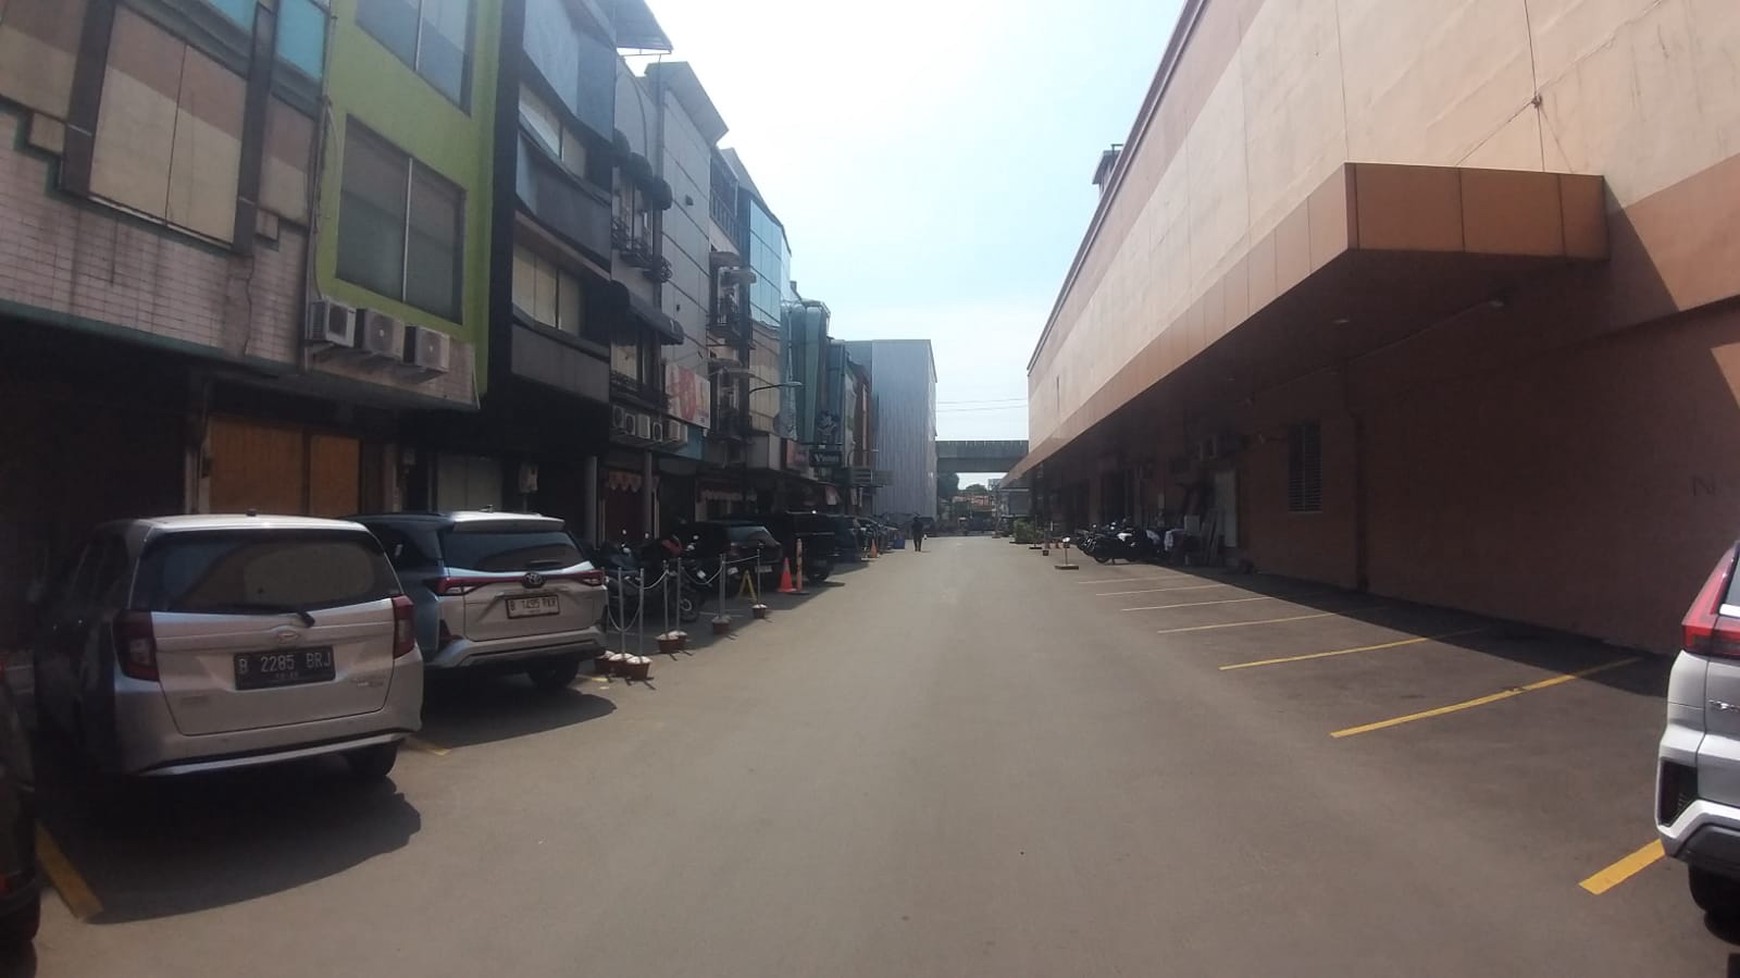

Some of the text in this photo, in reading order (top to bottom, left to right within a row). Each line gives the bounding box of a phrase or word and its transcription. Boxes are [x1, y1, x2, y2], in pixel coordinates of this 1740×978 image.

[238, 652, 332, 674] B 2285 BRJ
